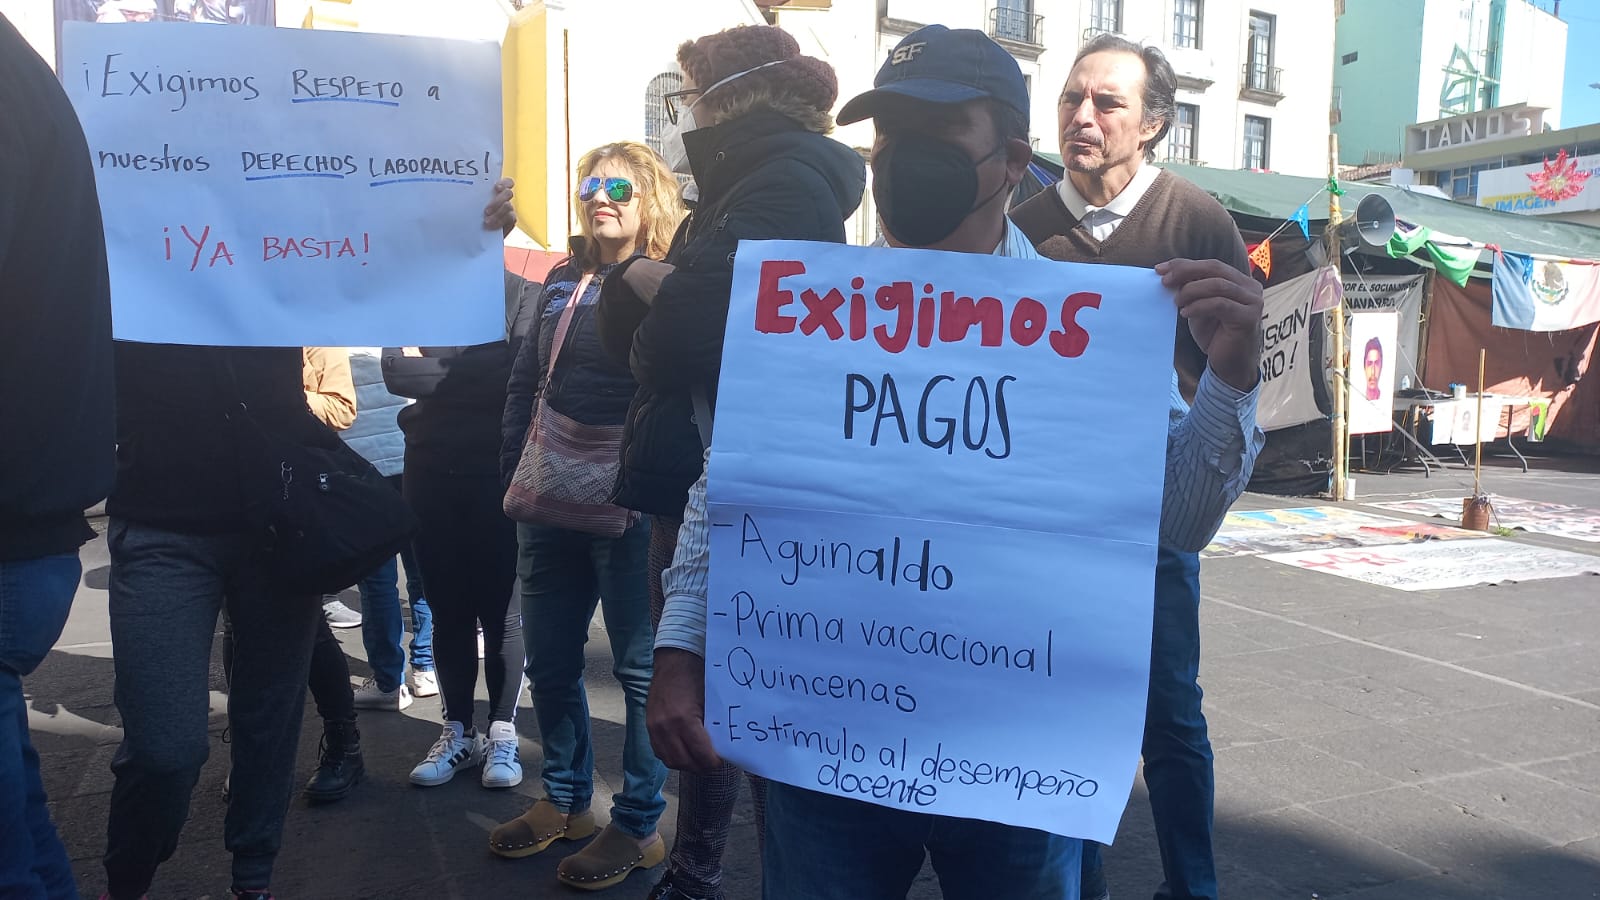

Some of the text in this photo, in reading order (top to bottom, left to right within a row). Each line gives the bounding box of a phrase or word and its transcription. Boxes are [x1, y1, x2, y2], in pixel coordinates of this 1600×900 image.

[891, 41, 928, 66] SF
[292, 69, 404, 101] RESPETO
[427, 86, 441, 100] a
[98, 144, 491, 181] nuestros DERECHOS LABORALES!
[262, 232, 370, 266] BASTA!
[1342, 283, 1357, 291] OR
[754, 259, 1102, 358] Exigimos
[843, 372, 1017, 459] PAGOS
[860, 619, 1053, 677] vacacional
[817, 759, 937, 806] docente
[878, 737, 907, 772] al
[920, 742, 1099, 801] desempeño
